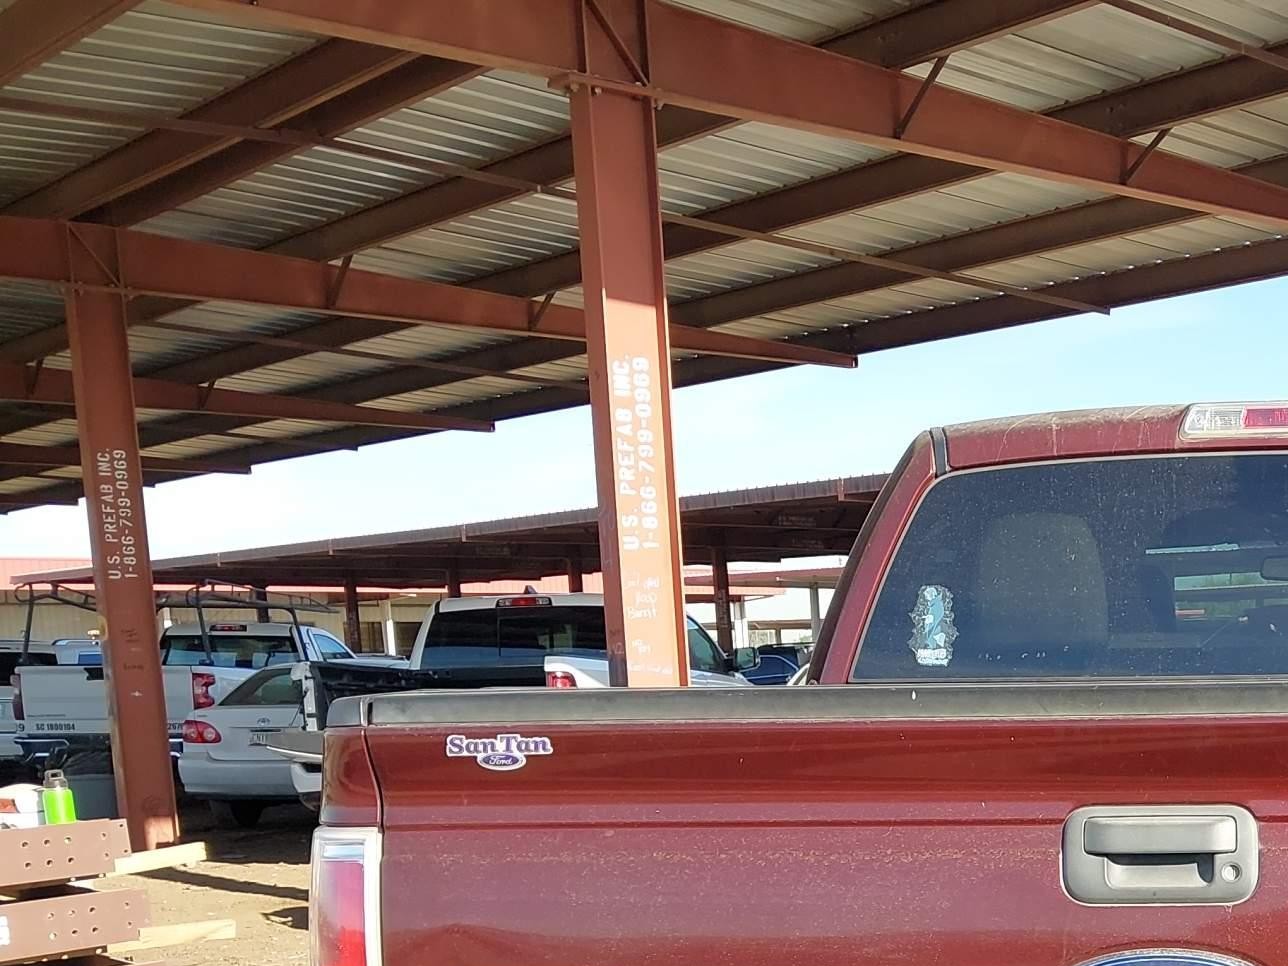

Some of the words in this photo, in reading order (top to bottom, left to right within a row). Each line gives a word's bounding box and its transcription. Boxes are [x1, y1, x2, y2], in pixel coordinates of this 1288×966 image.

[611, 353, 632, 398] INC.
[96, 447, 113, 477] INC.
[614, 407, 638, 496] PREFAB
[631, 356, 660, 550] 1-866-799-0969
[99, 484, 119, 542] PREFAB
[112, 449, 139, 579] 1-866-799-0969
[621, 508, 641, 551] U.S.
[107, 551, 122, 580] U.S.
